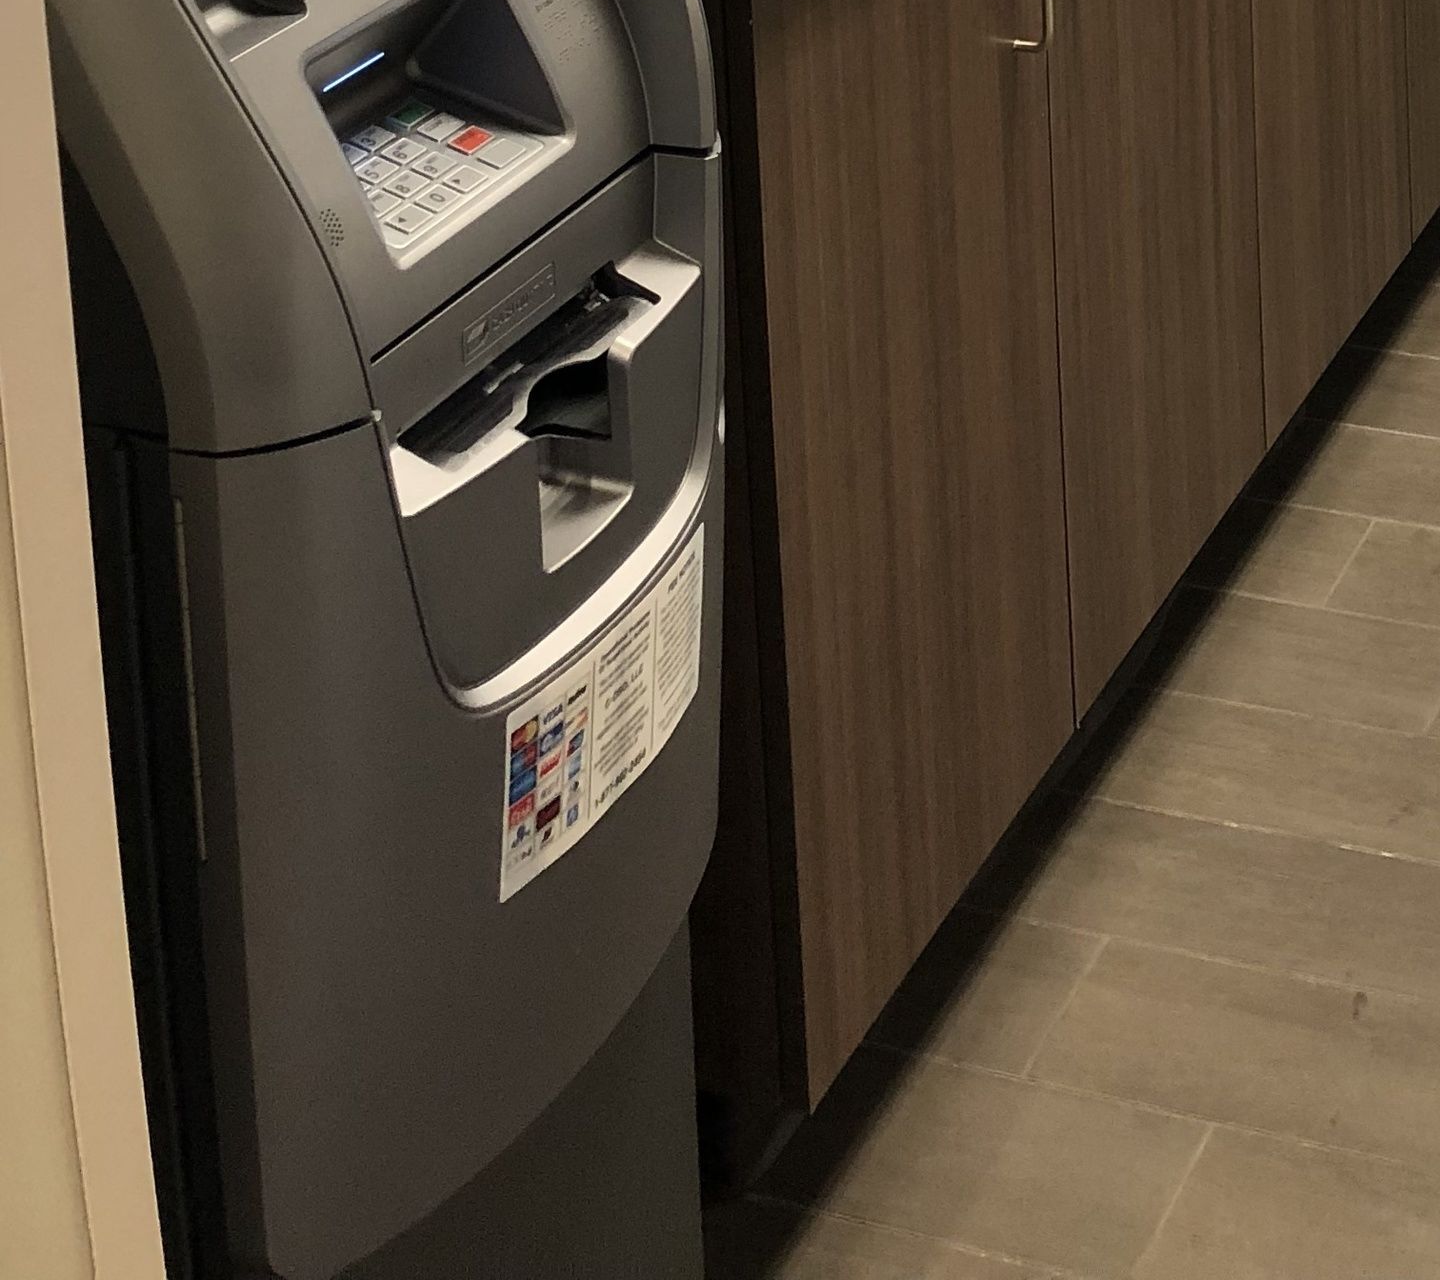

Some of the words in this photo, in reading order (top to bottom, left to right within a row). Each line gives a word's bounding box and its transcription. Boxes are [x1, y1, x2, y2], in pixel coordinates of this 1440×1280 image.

[364, 166, 380, 180] 5
[395, 183, 411, 194] 8
[429, 192, 446, 203] 0
